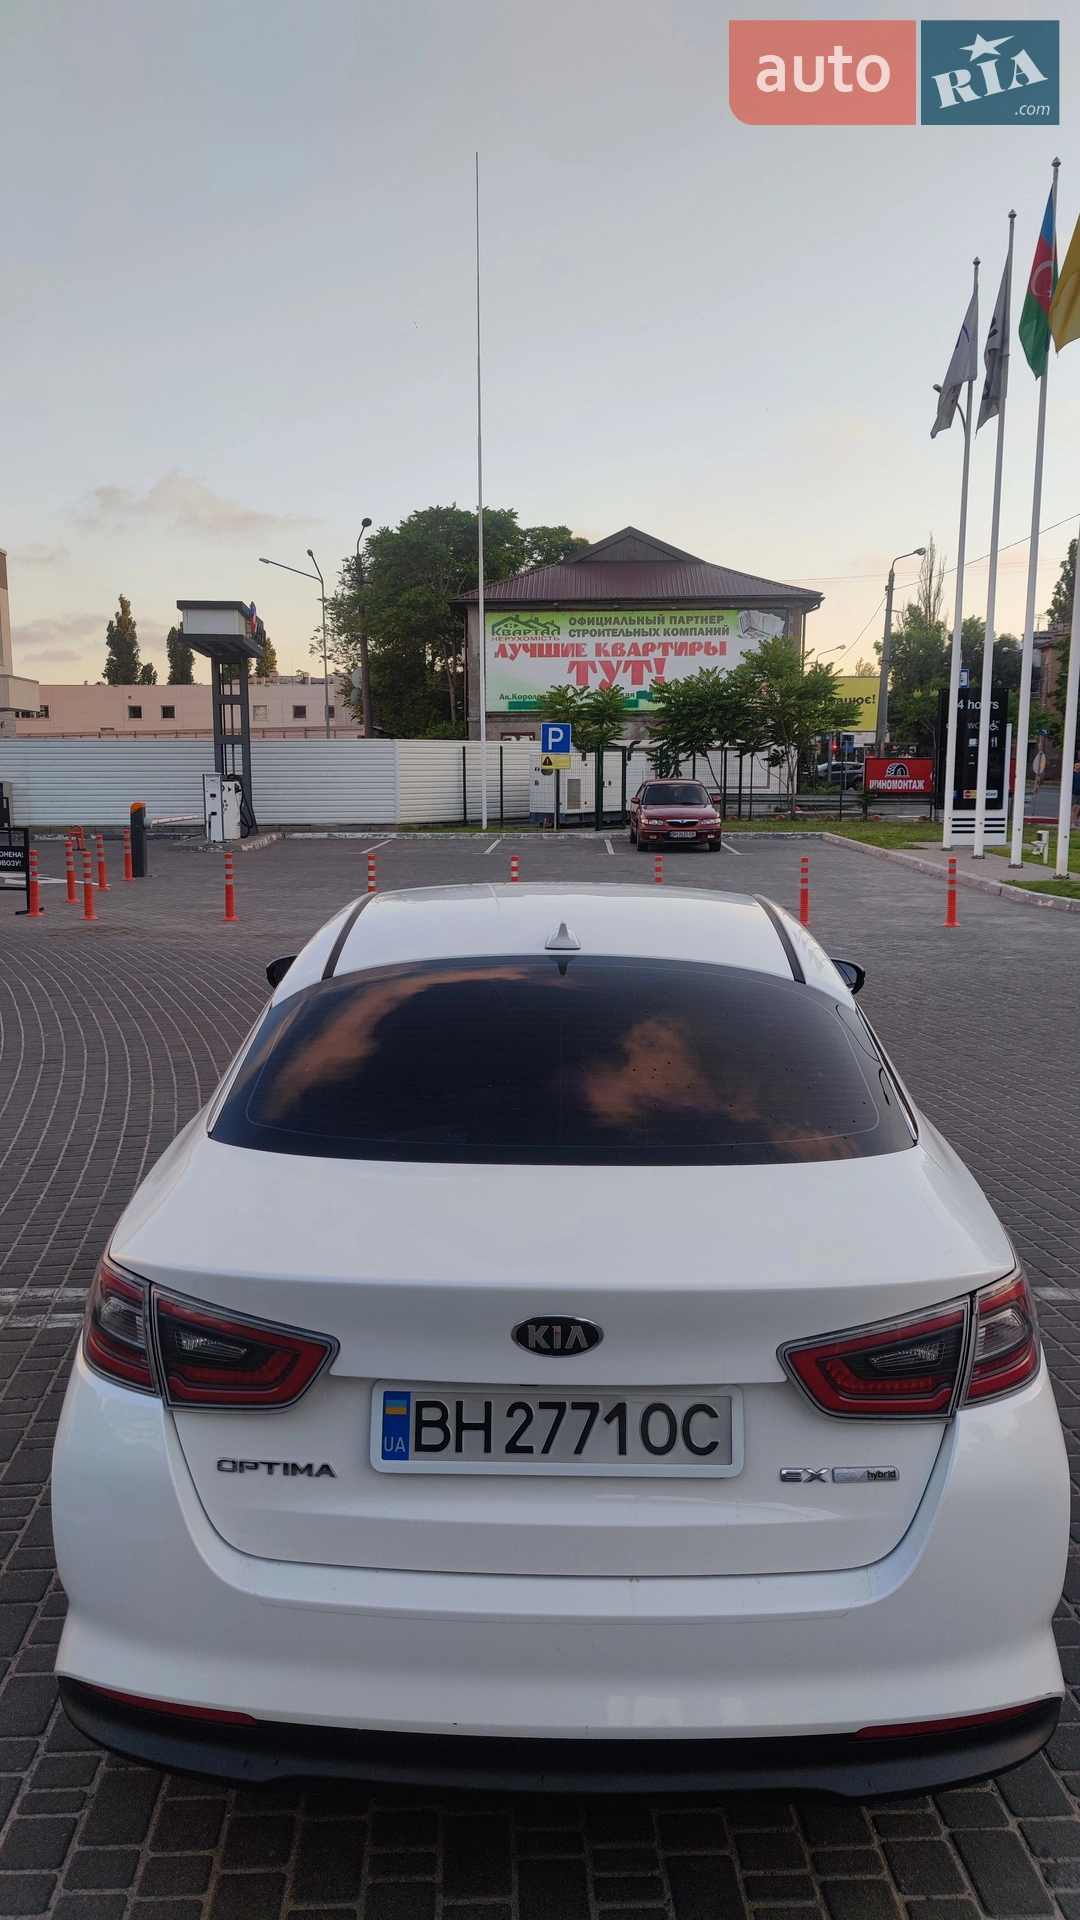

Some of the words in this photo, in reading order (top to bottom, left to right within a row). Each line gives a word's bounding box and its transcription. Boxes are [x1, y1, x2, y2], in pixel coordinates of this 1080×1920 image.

[568, 614, 665, 627] ОФИЦИАЛЬНЫЙ
[669, 615, 725, 625] ПАРТНЕР
[568, 628, 660, 638] СТРОИТЕЛЬНЫХ
[663, 624, 730, 637] КОМПАНИЙ
[494, 643, 588, 661] ЛУЧШИЕ
[595, 641, 727, 657] КВАРТИРЫ
[567, 657, 666, 691] ТУТ!
[548, 727, 564, 751] P
[869, 780, 925, 790] ШИНОМОНТАЖ
[527, 1325, 589, 1349] KIA
[384, 1436, 406, 1453] UA
[217, 1457, 337, 1478] OPTIMA
[780, 1467, 829, 1483] EX
[867, 1470, 896, 1480] hybrid
